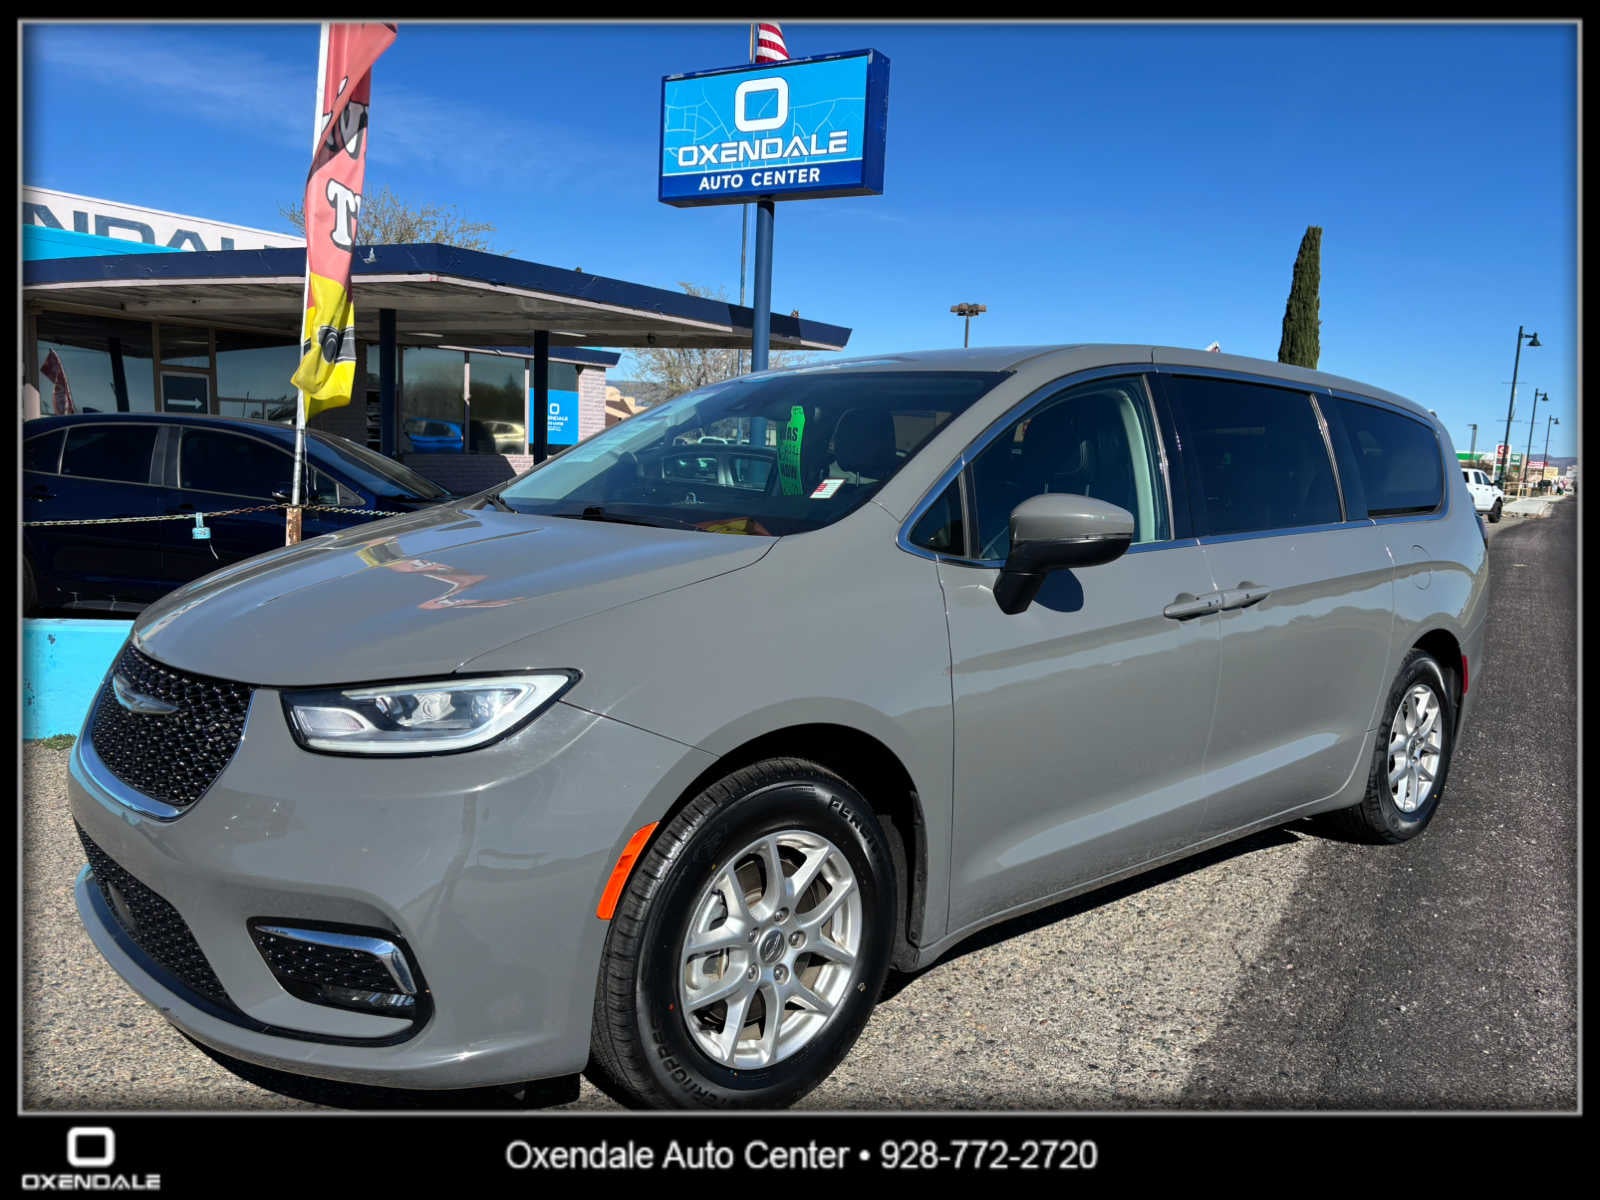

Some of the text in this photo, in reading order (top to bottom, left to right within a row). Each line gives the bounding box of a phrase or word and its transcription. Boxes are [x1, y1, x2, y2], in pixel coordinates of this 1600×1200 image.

[678, 131, 848, 167] OXENDALE
[698, 168, 820, 191] AUTO CENTER
